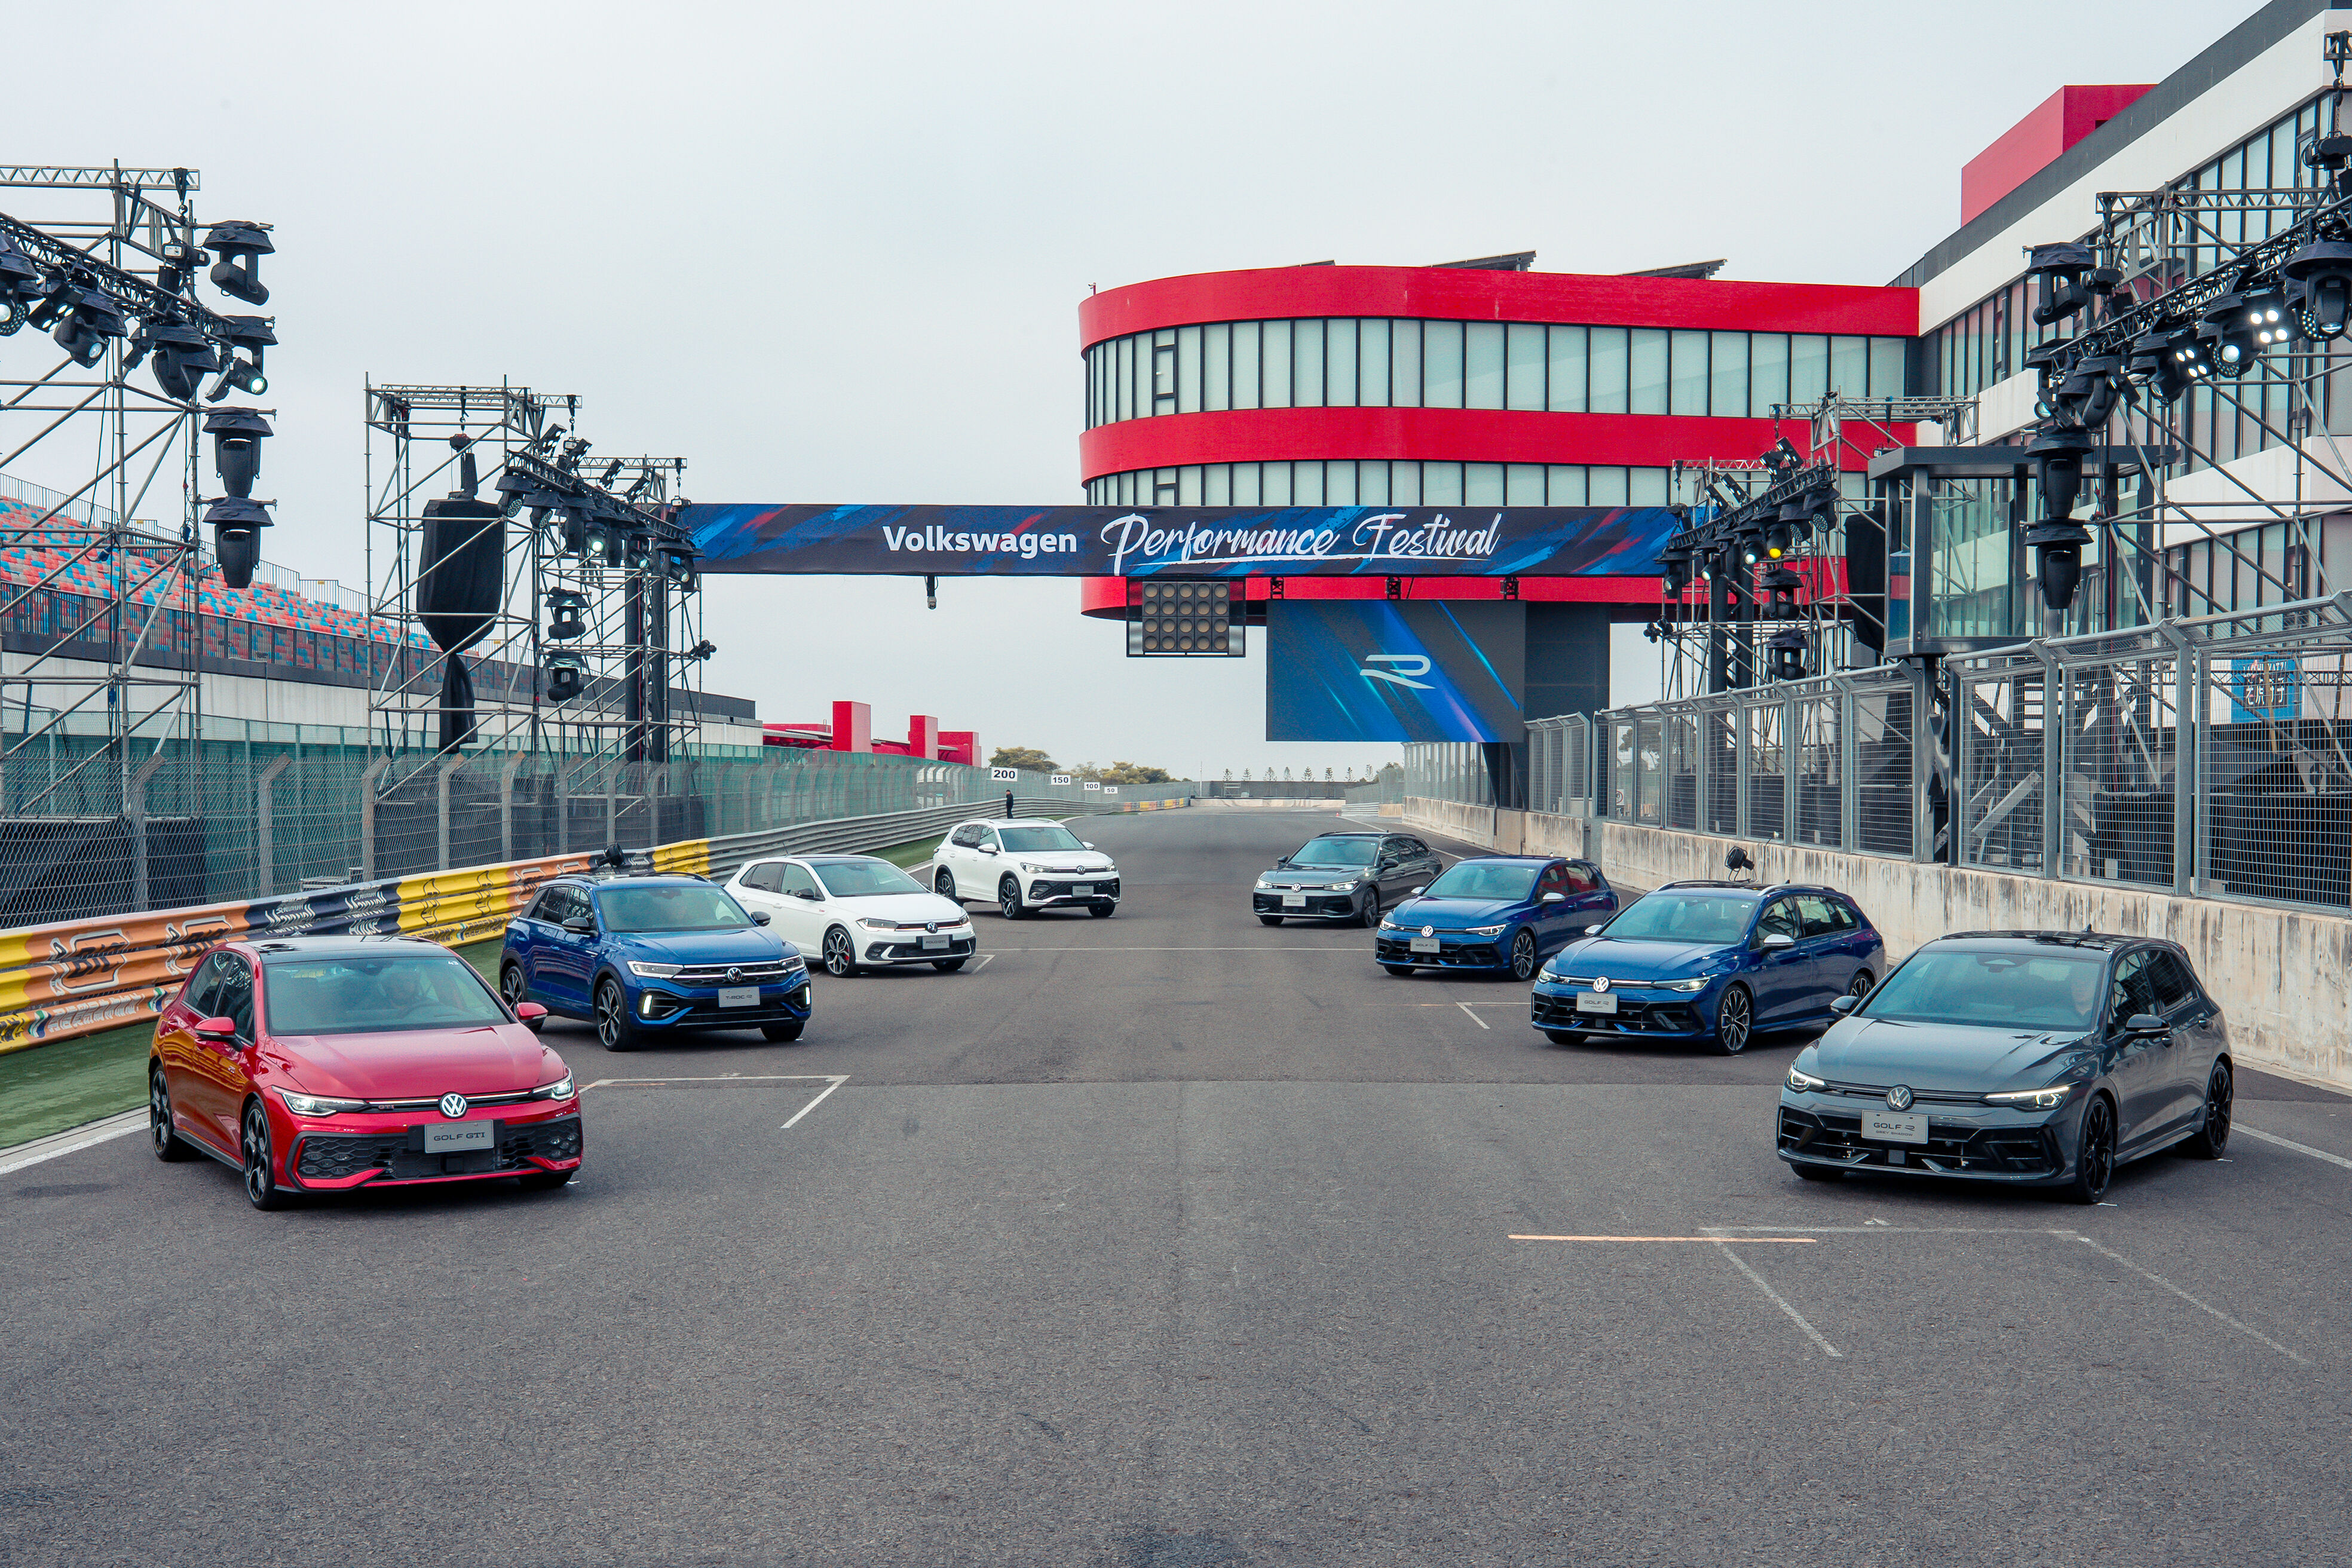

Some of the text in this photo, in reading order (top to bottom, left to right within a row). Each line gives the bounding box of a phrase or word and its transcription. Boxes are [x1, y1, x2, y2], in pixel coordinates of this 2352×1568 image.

[882, 512, 1502, 576] Volkswagen Performance Festival
[993, 769, 1016, 779] 200
[433, 1133, 464, 1141] GOLF
